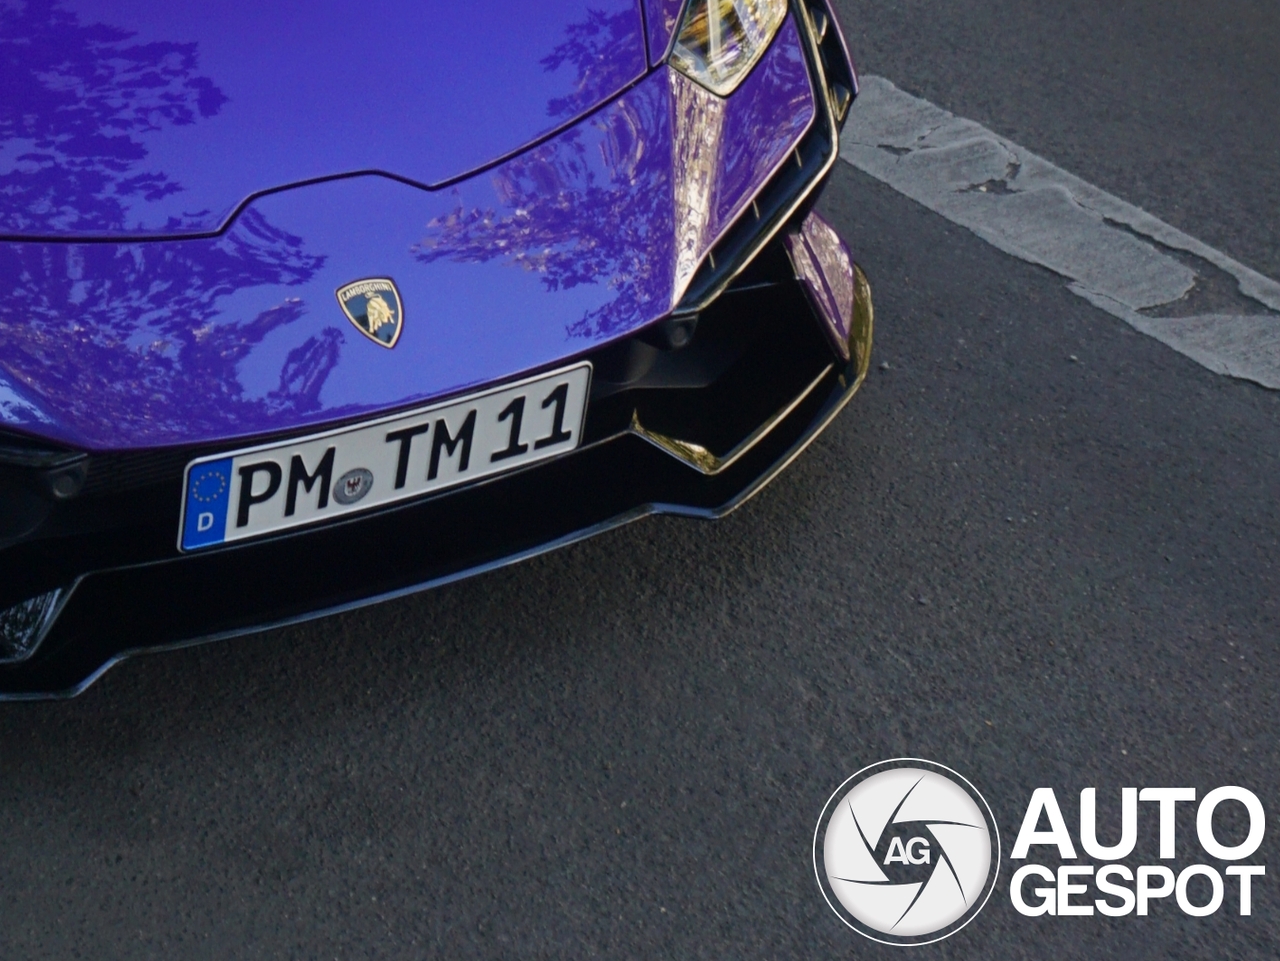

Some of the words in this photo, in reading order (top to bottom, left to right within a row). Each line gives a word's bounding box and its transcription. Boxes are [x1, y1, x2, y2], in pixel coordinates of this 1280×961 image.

[341, 282, 392, 301] LAMBORGHINI
[236, 446, 336, 528] PM
[385, 408, 478, 490] TM
[489, 382, 572, 463] 11
[197, 511, 214, 532] D
